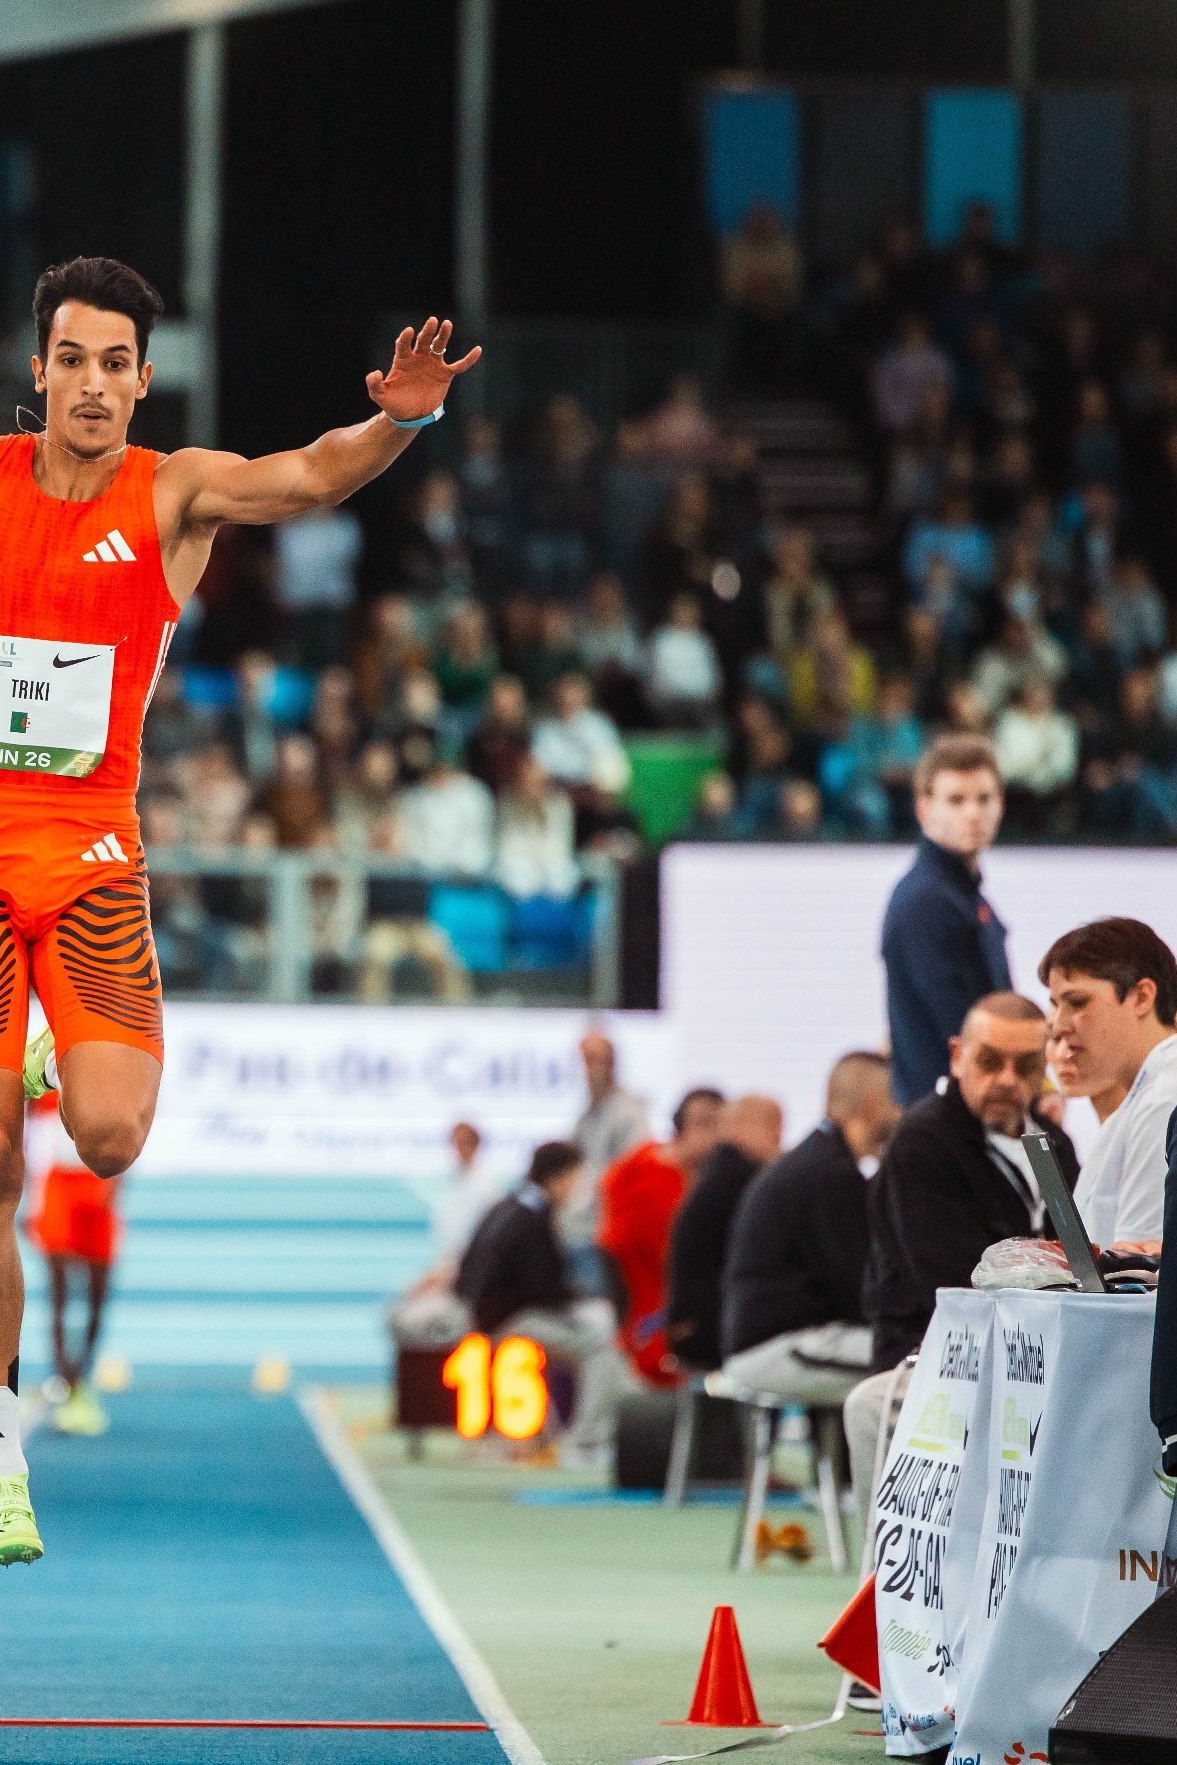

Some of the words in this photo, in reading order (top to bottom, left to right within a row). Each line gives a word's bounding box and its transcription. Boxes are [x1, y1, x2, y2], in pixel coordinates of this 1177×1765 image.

[11, 678, 50, 701] TRIKI
[24, 751, 51, 768] 26
[442, 1332, 550, 1441] 16
